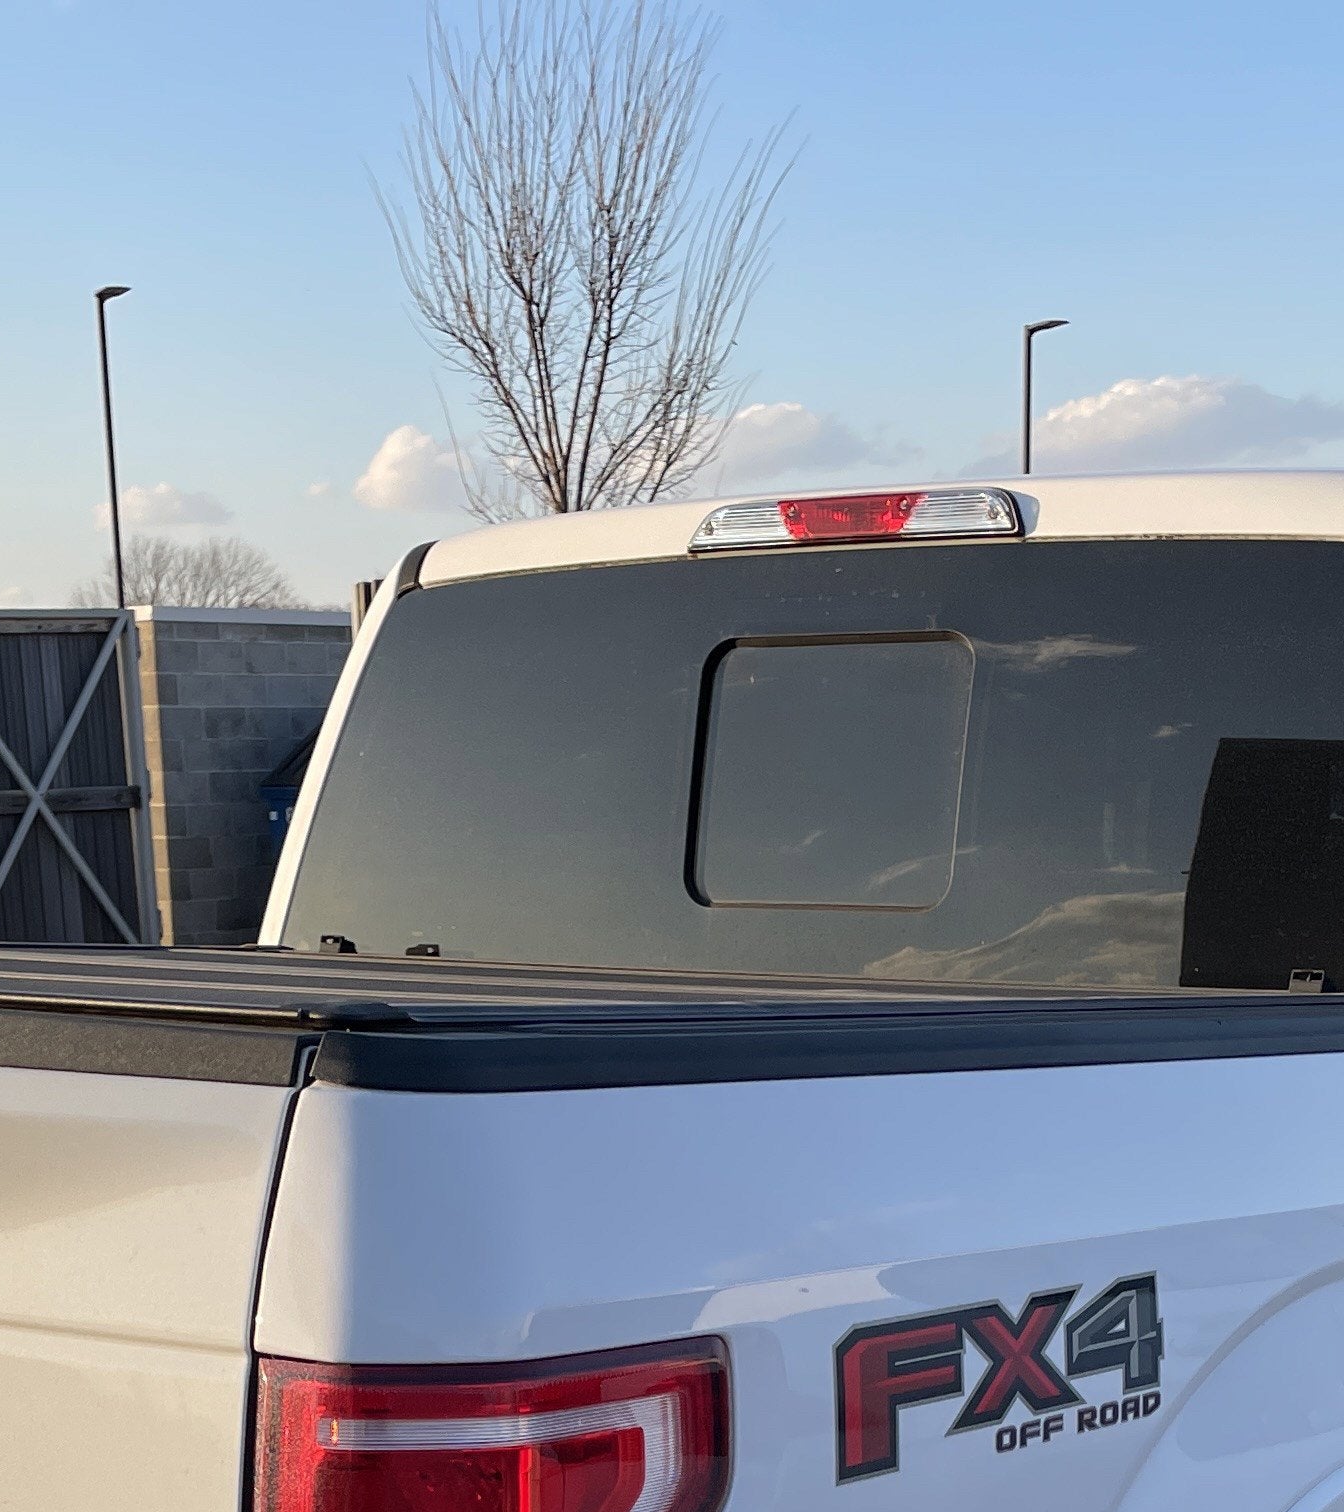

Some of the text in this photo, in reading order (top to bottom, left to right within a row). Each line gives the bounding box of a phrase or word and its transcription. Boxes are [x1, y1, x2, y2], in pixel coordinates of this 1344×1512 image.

[832, 1270, 1164, 1486] FX4
[995, 1391, 1162, 1454] OFF ROAD
